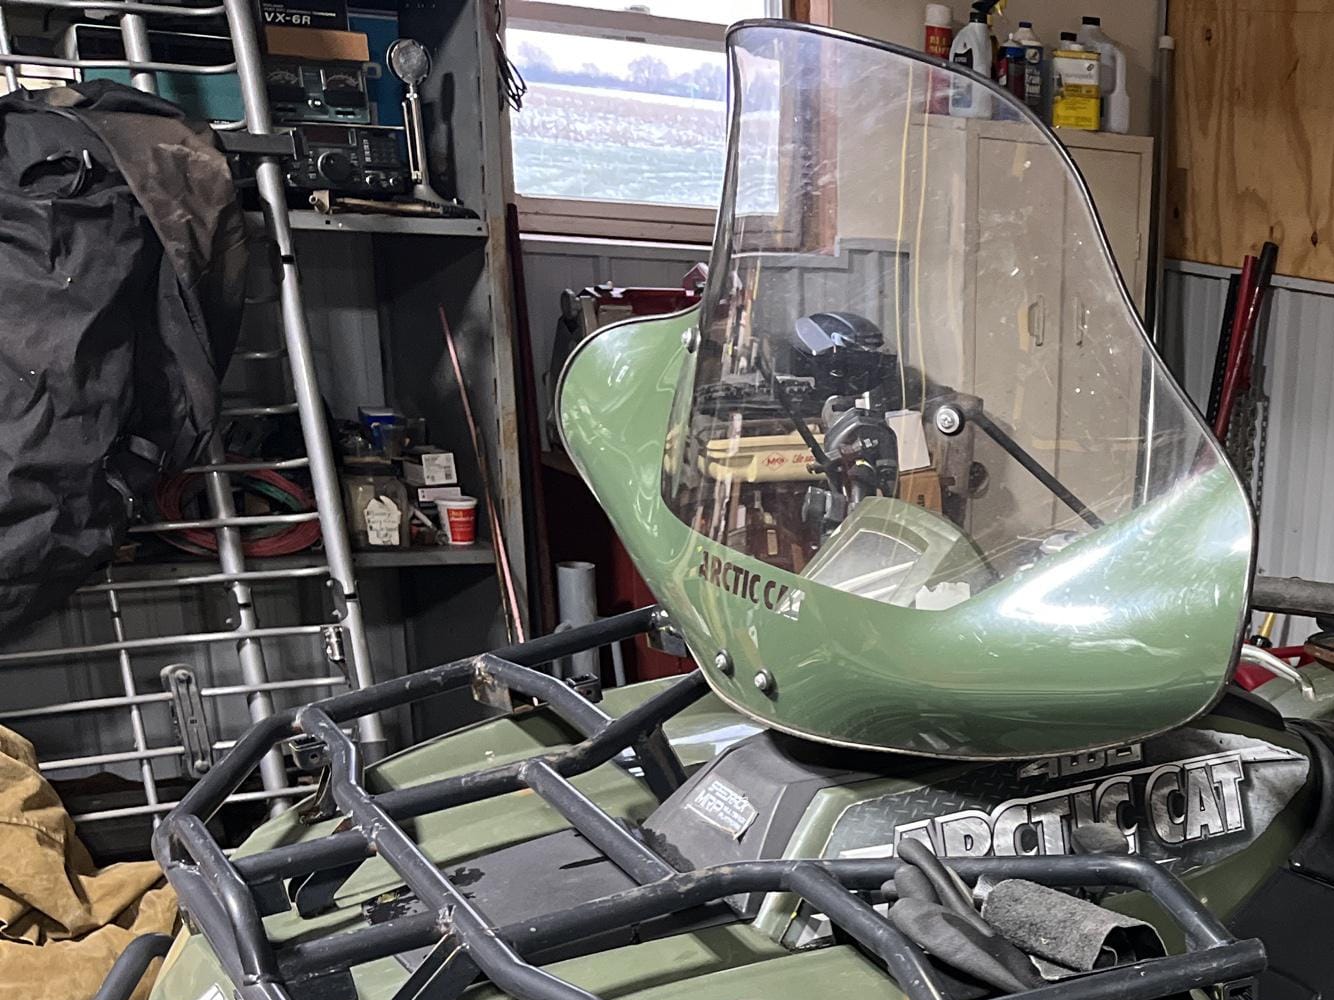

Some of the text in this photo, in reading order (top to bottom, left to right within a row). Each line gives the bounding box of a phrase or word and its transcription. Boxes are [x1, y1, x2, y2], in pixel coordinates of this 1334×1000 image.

[264, 12, 311, 25] VX-6R
[699, 550, 761, 604] ARCTIC
[1145, 753, 1245, 847] CAT
